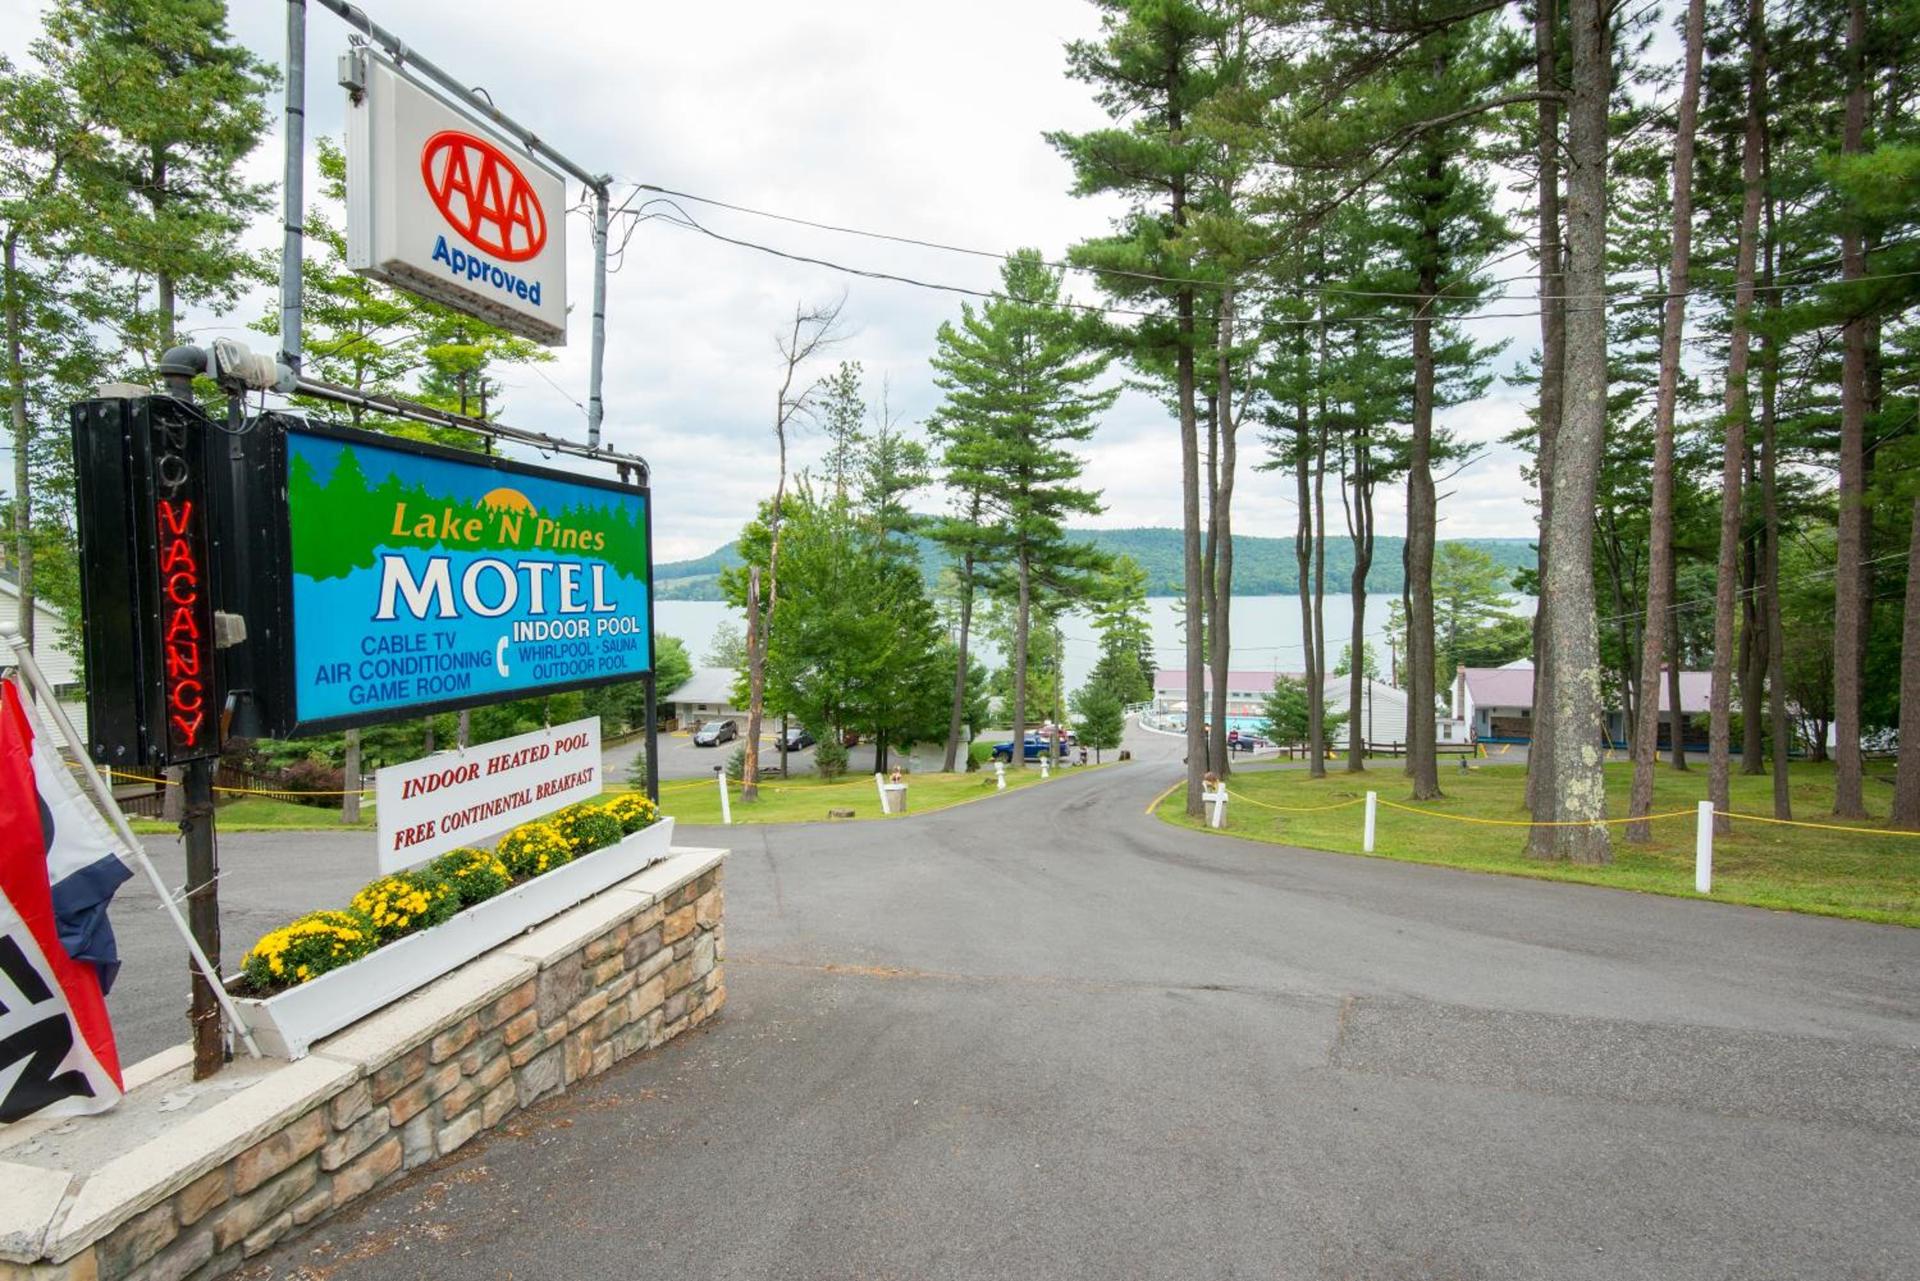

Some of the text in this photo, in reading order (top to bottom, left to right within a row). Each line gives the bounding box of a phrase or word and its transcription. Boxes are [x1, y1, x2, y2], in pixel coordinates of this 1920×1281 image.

[428, 134, 543, 259] AAA
[431, 235, 541, 305] Approved
[390, 502, 484, 542] Lake
[534, 518, 605, 551] Pines
[372, 554, 618, 621] MOTEL
[158, 499, 203, 747] VACANCY
[361, 632, 456, 656] CABLE TV
[513, 616, 640, 642] INDOOR POOL
[315, 650, 492, 685] AIR CONDITIONING
[519, 637, 637, 663] WHIRLPOOL SAUNA
[533, 655, 628, 680] OUTDOOR POOL
[349, 673, 471, 705] GAME ROOM
[401, 733, 589, 800] INDOOR HEATED POOL
[393, 767, 594, 851] FREE CONTINENTAL BREAKFAST
